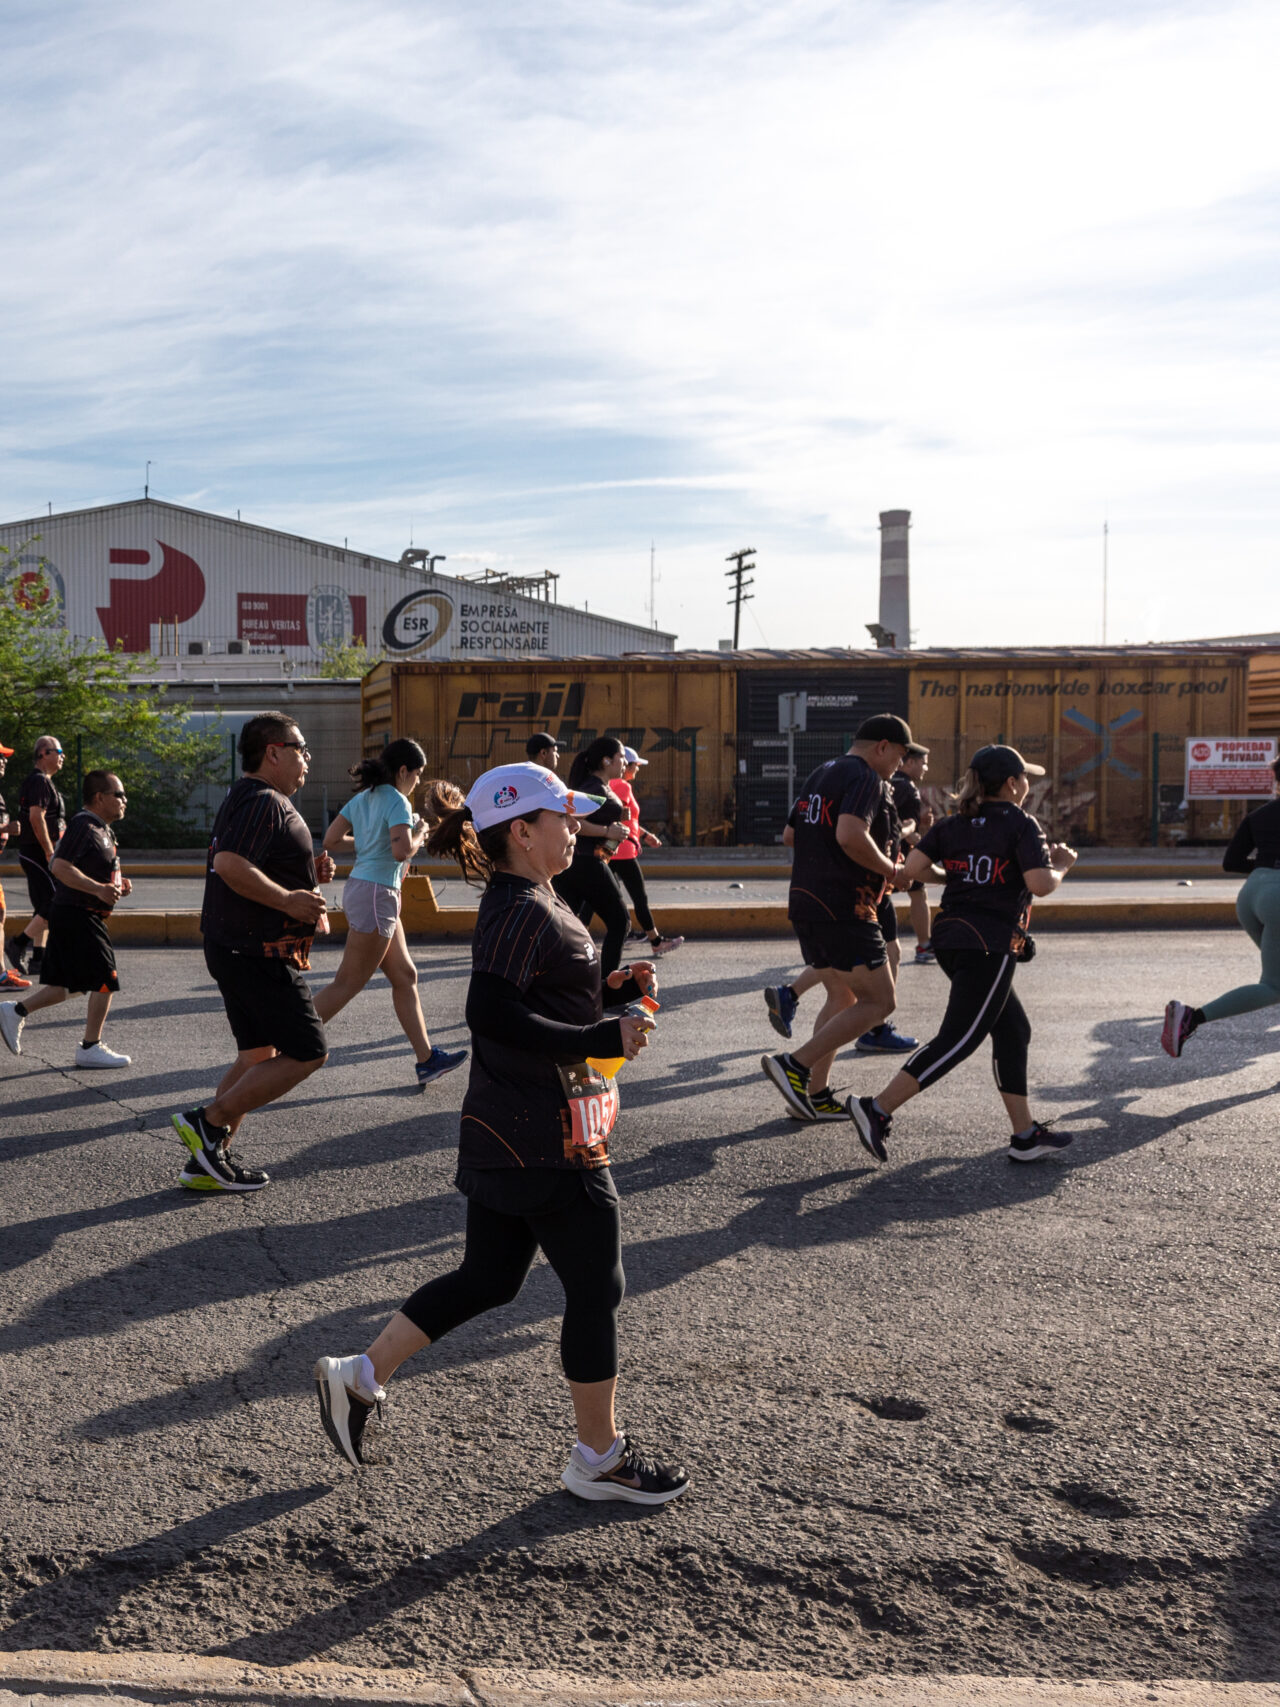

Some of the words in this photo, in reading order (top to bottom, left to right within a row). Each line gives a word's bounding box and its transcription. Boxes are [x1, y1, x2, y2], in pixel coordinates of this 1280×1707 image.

[460, 604, 518, 618] EMPRESA
[242, 619, 269, 630] BUREAU
[271, 621, 300, 631] VERITAS
[403, 617, 429, 631] ESR
[460, 620, 549, 634] SOCIALMENTE
[460, 636, 549, 650] RESPONSABLE
[919, 679, 959, 697] The
[964, 678, 1090, 697] nationwide
[1097, 678, 1175, 697] boxcar
[1177, 677, 1228, 699] pool
[457, 682, 586, 718] rail
[1215, 742, 1272, 752] PROPIEDAD
[1222, 753, 1266, 762] PRIVADA
[804, 793, 834, 827] 10K
[962, 854, 1010, 884] 10K
[577, 1090, 615, 1143] 1057
